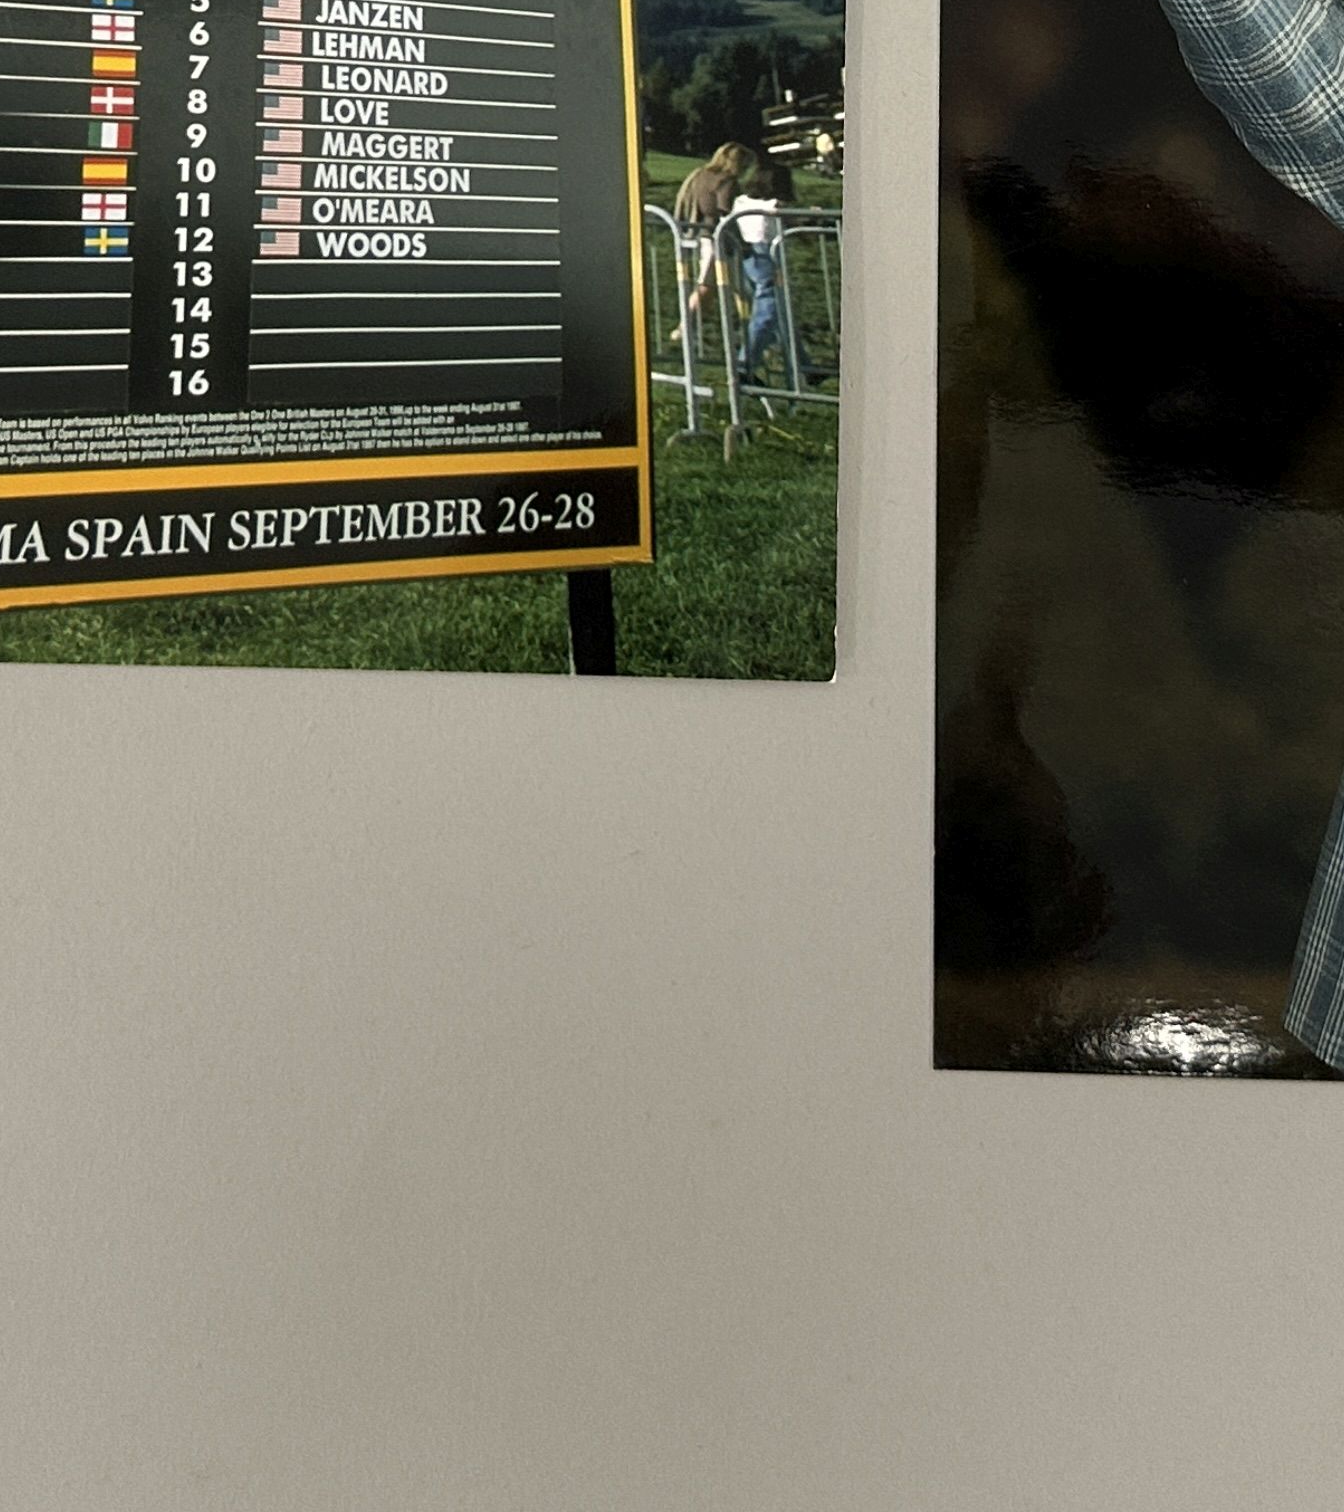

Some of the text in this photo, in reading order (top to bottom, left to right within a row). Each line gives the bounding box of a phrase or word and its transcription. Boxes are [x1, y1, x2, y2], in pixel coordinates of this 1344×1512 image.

[316, 0, 423, 30] JANZEN
[189, 22, 209, 45] 6
[313, 31, 425, 63] LEHMAN
[189, 55, 209, 79] 7
[322, 65, 448, 95] LEONARD
[187, 89, 207, 114] 8
[321, 98, 388, 125] LOVE
[187, 124, 206, 148] 9
[322, 131, 453, 160] MAGGERT
[177, 158, 215, 182] 10
[314, 164, 470, 192] MICKELSON
[176, 192, 209, 217] 11
[313, 198, 434, 224] O'MEARA
[175, 227, 213, 251] 12
[317, 232, 426, 257] WOODS
[174, 262, 212, 286] 13
[172, 298, 212, 322] 14
[171, 334, 209, 358] 15
[169, 370, 208, 395] 16
[65, 510, 215, 561] SPAIN
[226, 499, 485, 551] SEPTEMBER
[498, 492, 596, 531] 26-28
